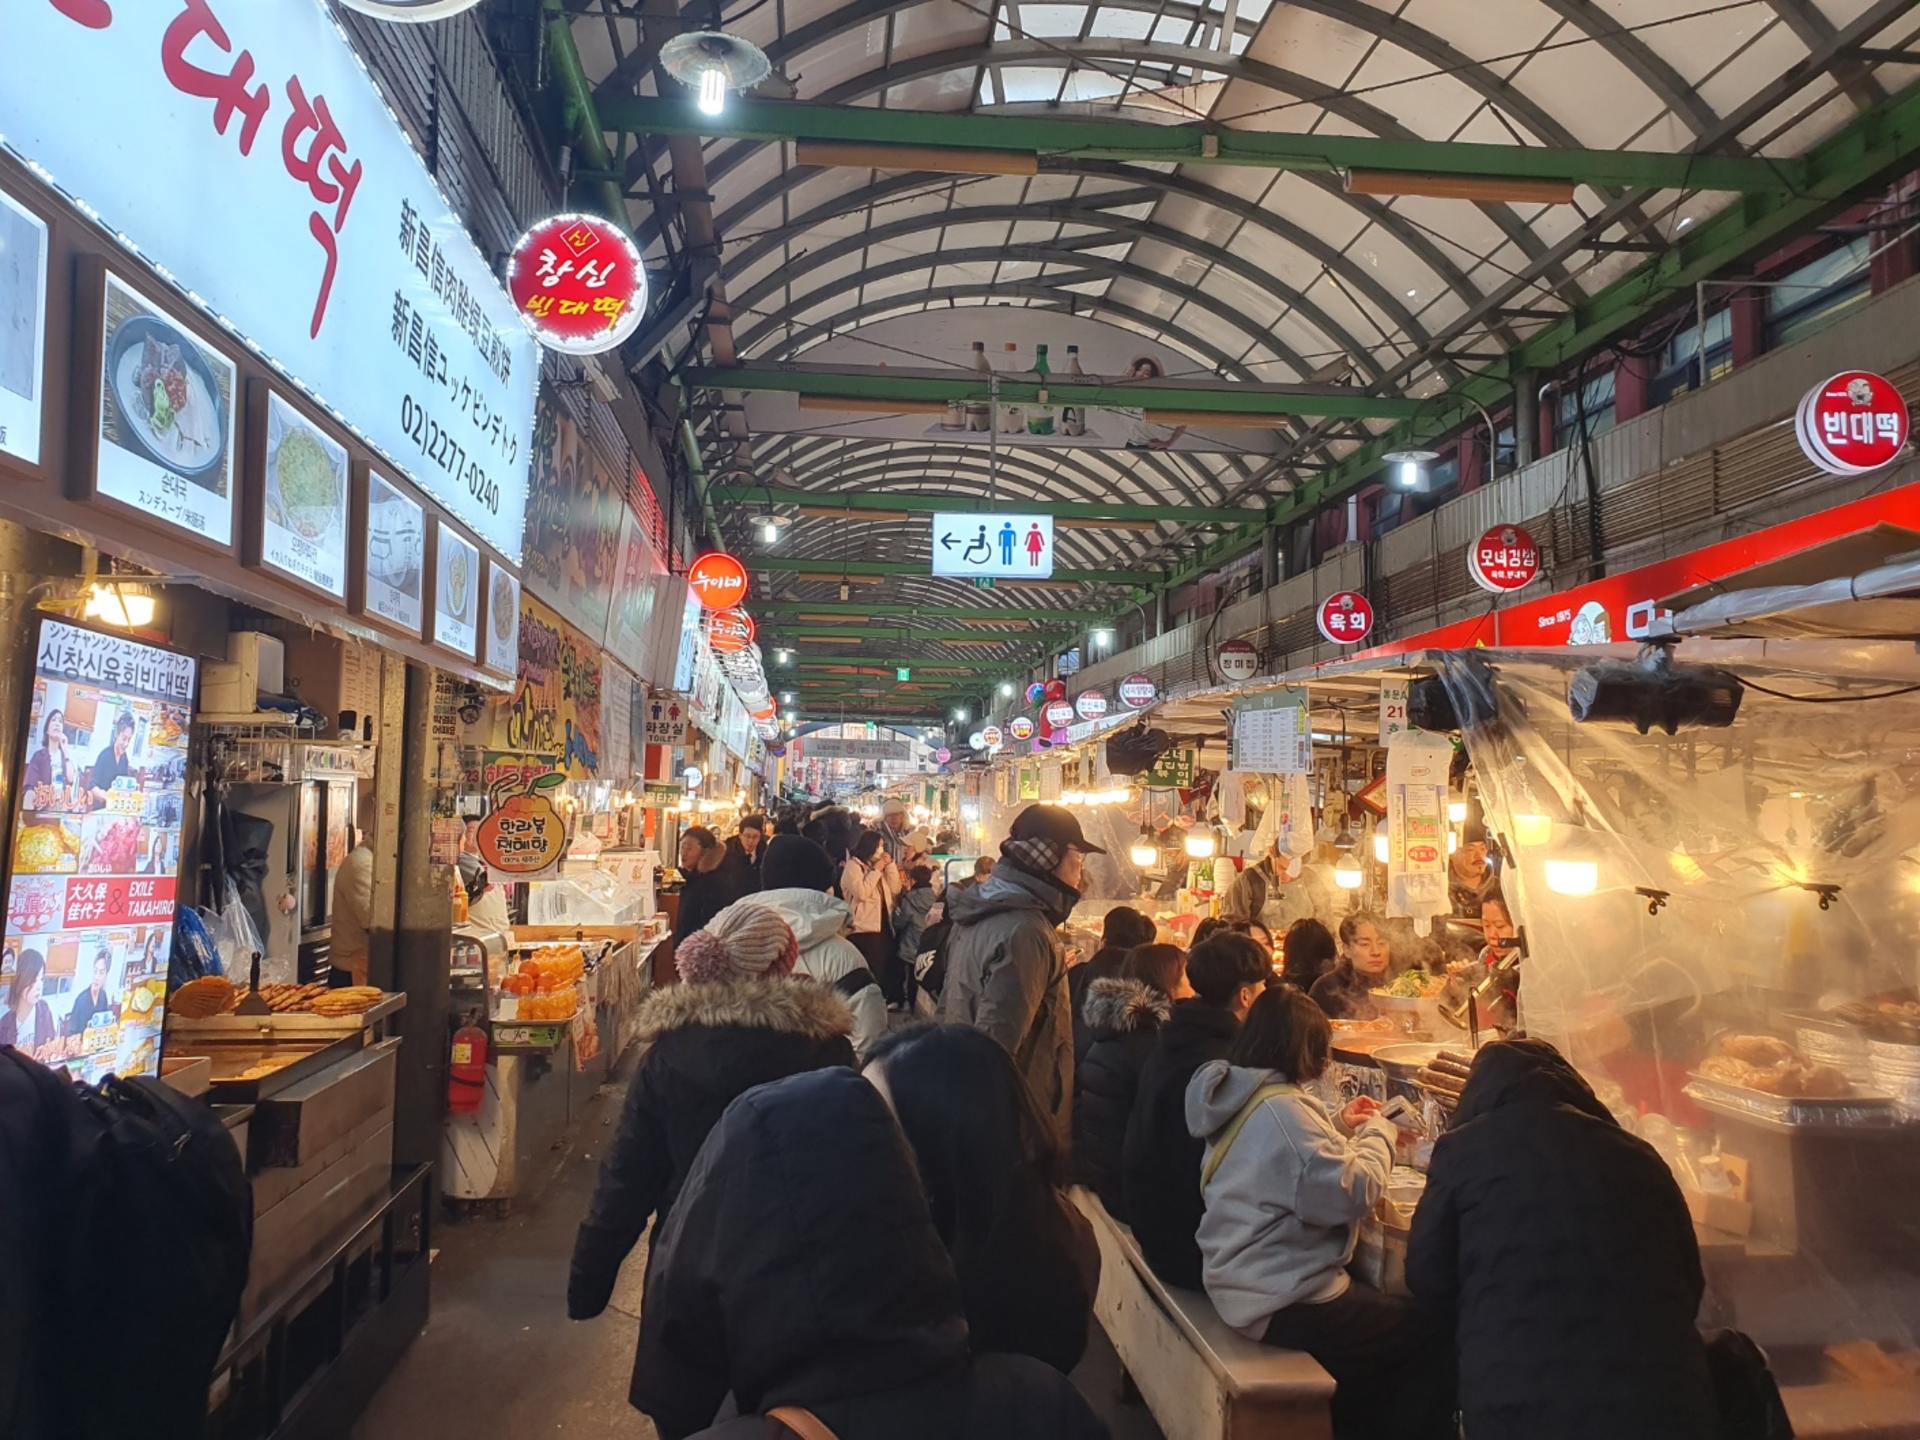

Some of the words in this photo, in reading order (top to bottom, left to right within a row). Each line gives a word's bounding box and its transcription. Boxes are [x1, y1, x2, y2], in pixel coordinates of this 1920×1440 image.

[48, 0, 363, 340] 대떡
[569, 229, 590, 247] 신
[536, 249, 615, 288] 창신
[526, 294, 625, 330] 빈대떡
[1823, 411, 1899, 447] 빈대떡
[401, 394, 499, 516] 02)2277-0240
[1481, 548, 1536, 567] 모녀김밥
[1330, 612, 1366, 632] 육회
[1538, 612, 1555, 628] Since
[1556, 609, 1572, 623] 1975
[50, 623, 121, 651] シンチャンシン
[41, 642, 190, 702] 신창신육회빈대떡
[1223, 658, 1255, 669] 장미집
[1387, 706, 1403, 718] 21
[646, 722, 684, 734] 화장실
[648, 735, 678, 743] TOILET
[465, 770, 480, 783] 23
[499, 816, 545, 835] 한라봉
[496, 837, 548, 853] 천혜향
[67, 882, 108, 901] 大久保
[128, 881, 155, 897] EXILE
[108, 888, 124, 915] &
[127, 899, 175, 917] TAKAHIRO
[67, 903, 106, 921] 佳代子
